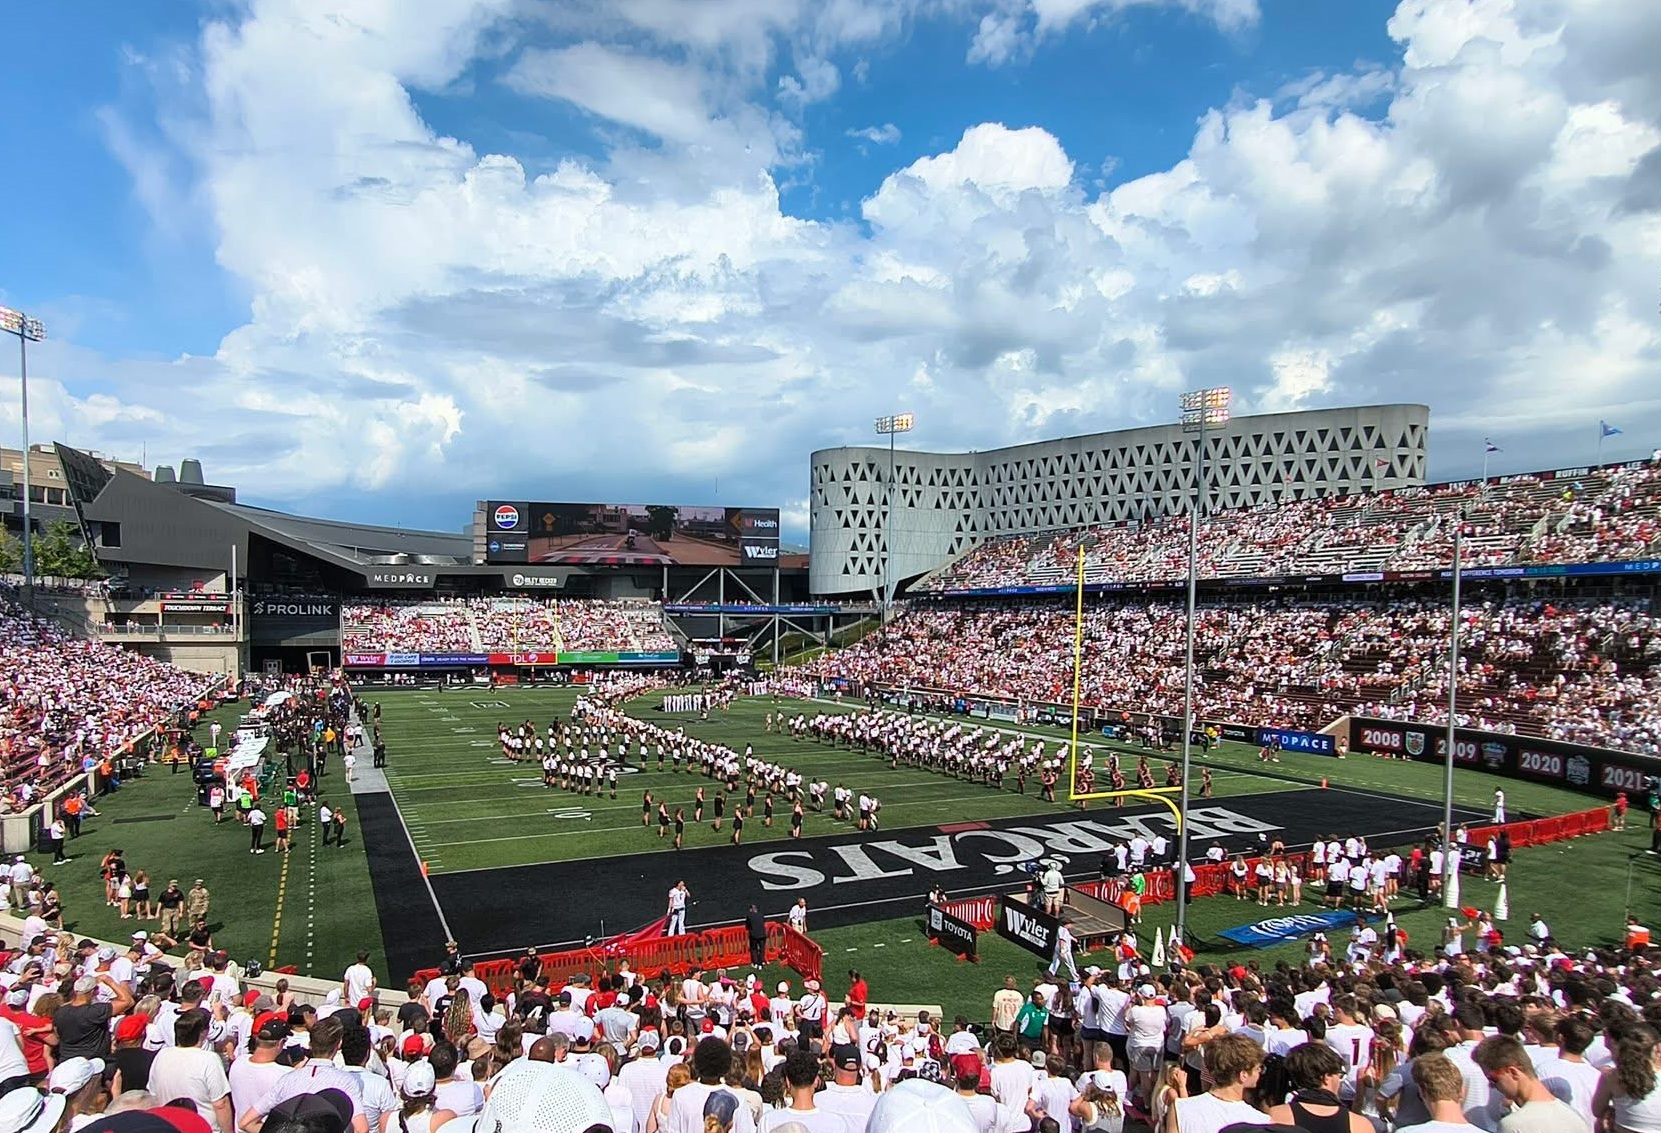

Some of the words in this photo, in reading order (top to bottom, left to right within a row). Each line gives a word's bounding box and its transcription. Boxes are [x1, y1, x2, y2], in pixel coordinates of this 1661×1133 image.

[1555, 467, 1589, 479] RUFFIN
[754, 519, 777, 528] Health
[744, 545, 778, 558] Wyler
[374, 573, 429, 583] MEDPACE
[267, 604, 332, 615] PROLINK
[508, 655, 528, 663] TQL
[1262, 733, 1328, 750] MDPACE
[1363, 730, 1400, 747] 2008
[1521, 752, 1561, 774] 2020
[1604, 766, 1643, 791] 2021
[748, 807, 1285, 891] BEARCATS
[943, 920, 973, 943] TOYOTA
[1005, 906, 1050, 941] Wyler
